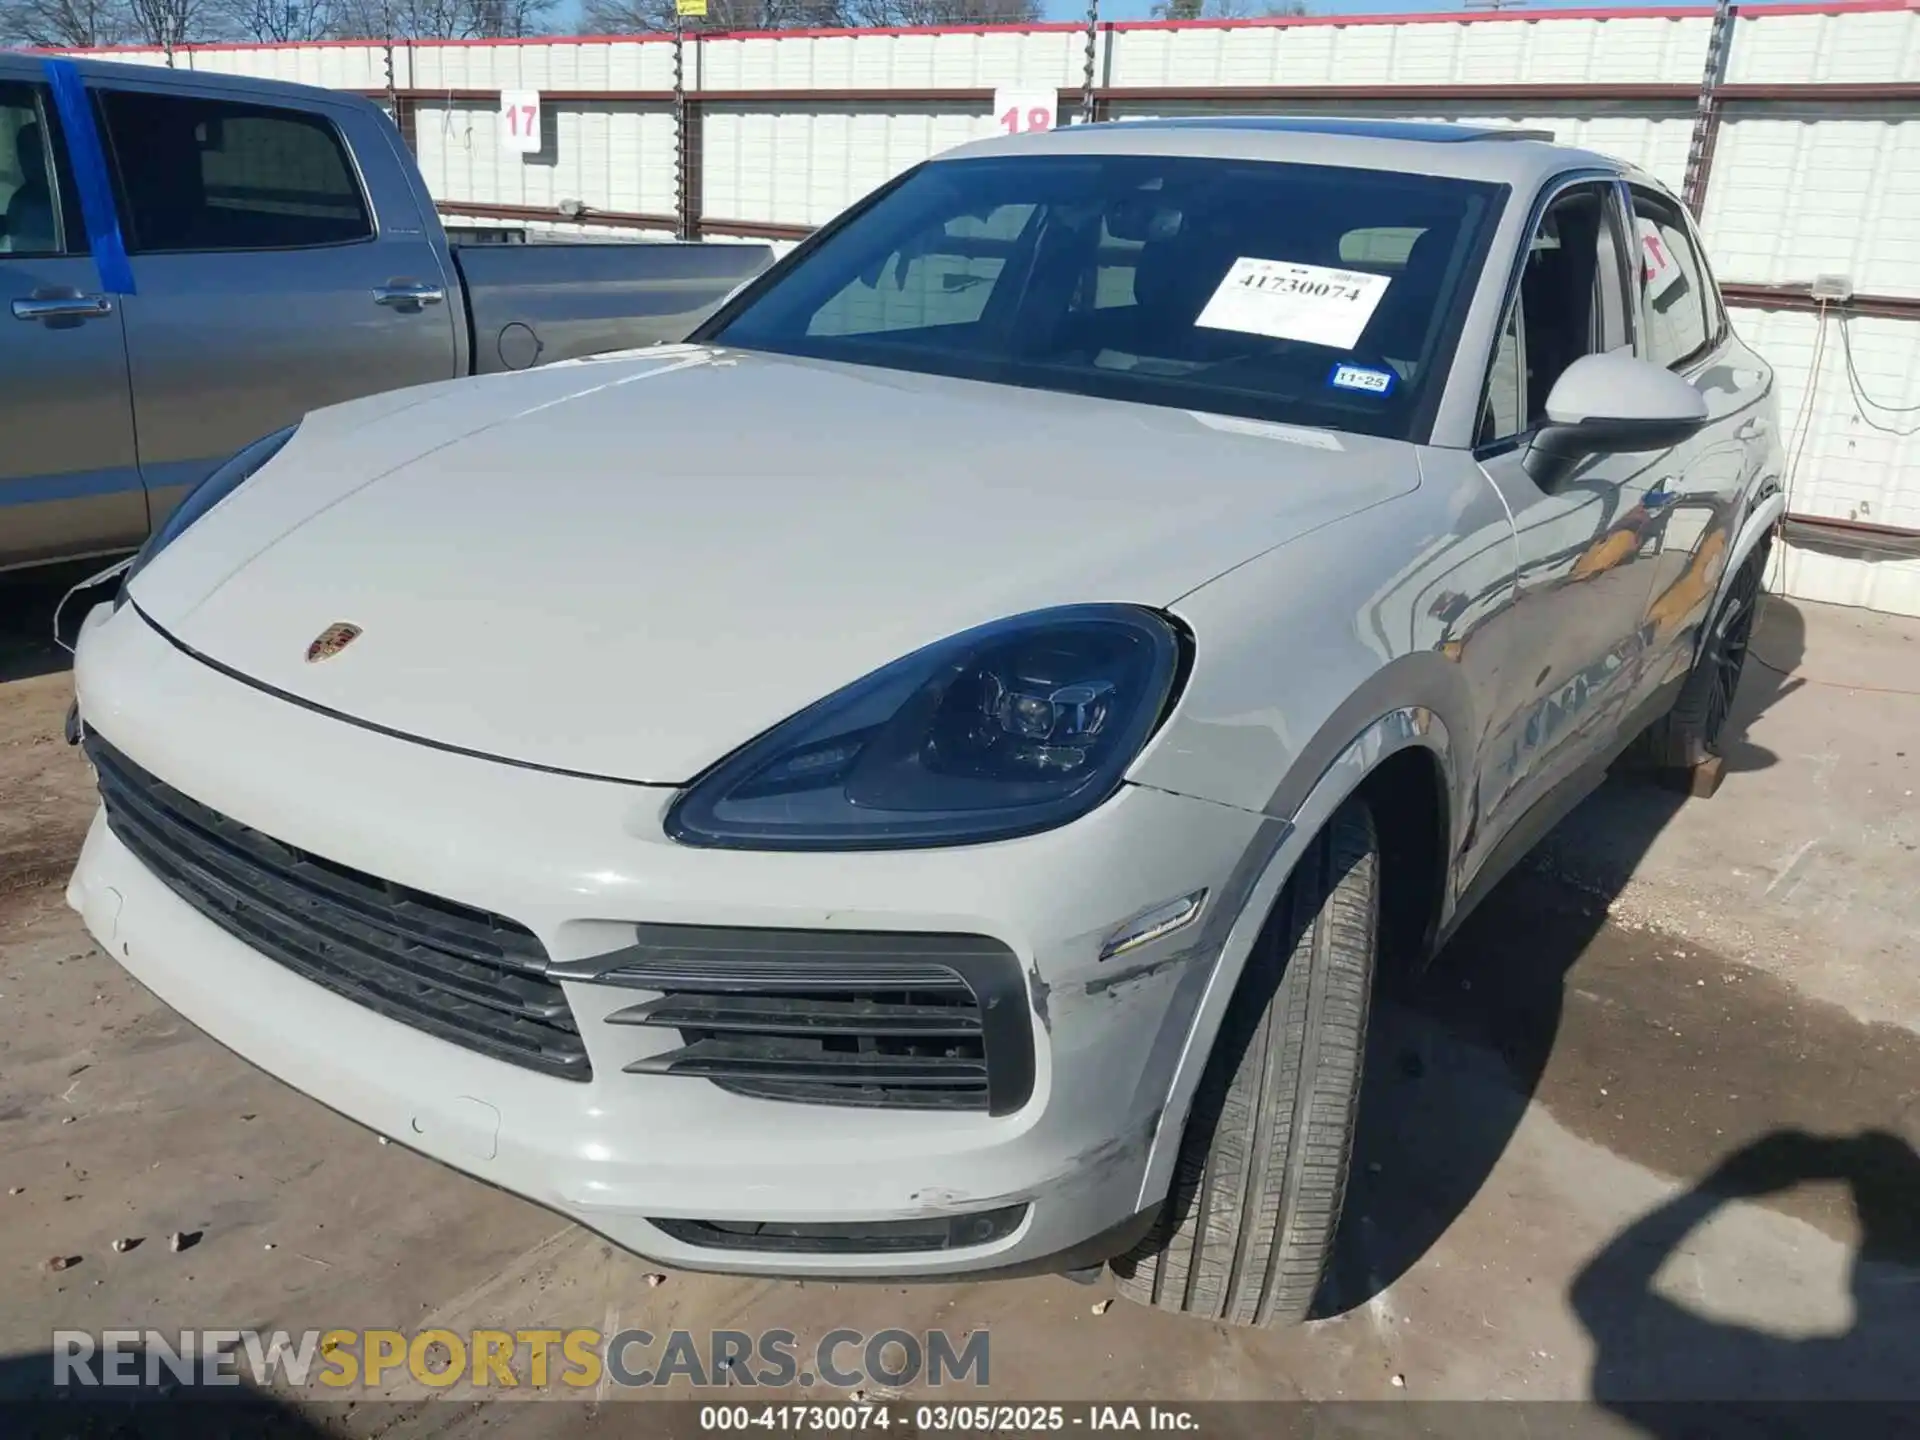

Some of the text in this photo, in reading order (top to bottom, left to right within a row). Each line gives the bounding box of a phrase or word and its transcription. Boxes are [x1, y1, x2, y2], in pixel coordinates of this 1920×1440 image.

[506, 104, 537, 137] 17
[1000, 107, 1050, 134] 18
[1238, 274, 1361, 302] 41730074
[1340, 372, 1385, 388] 11-25
